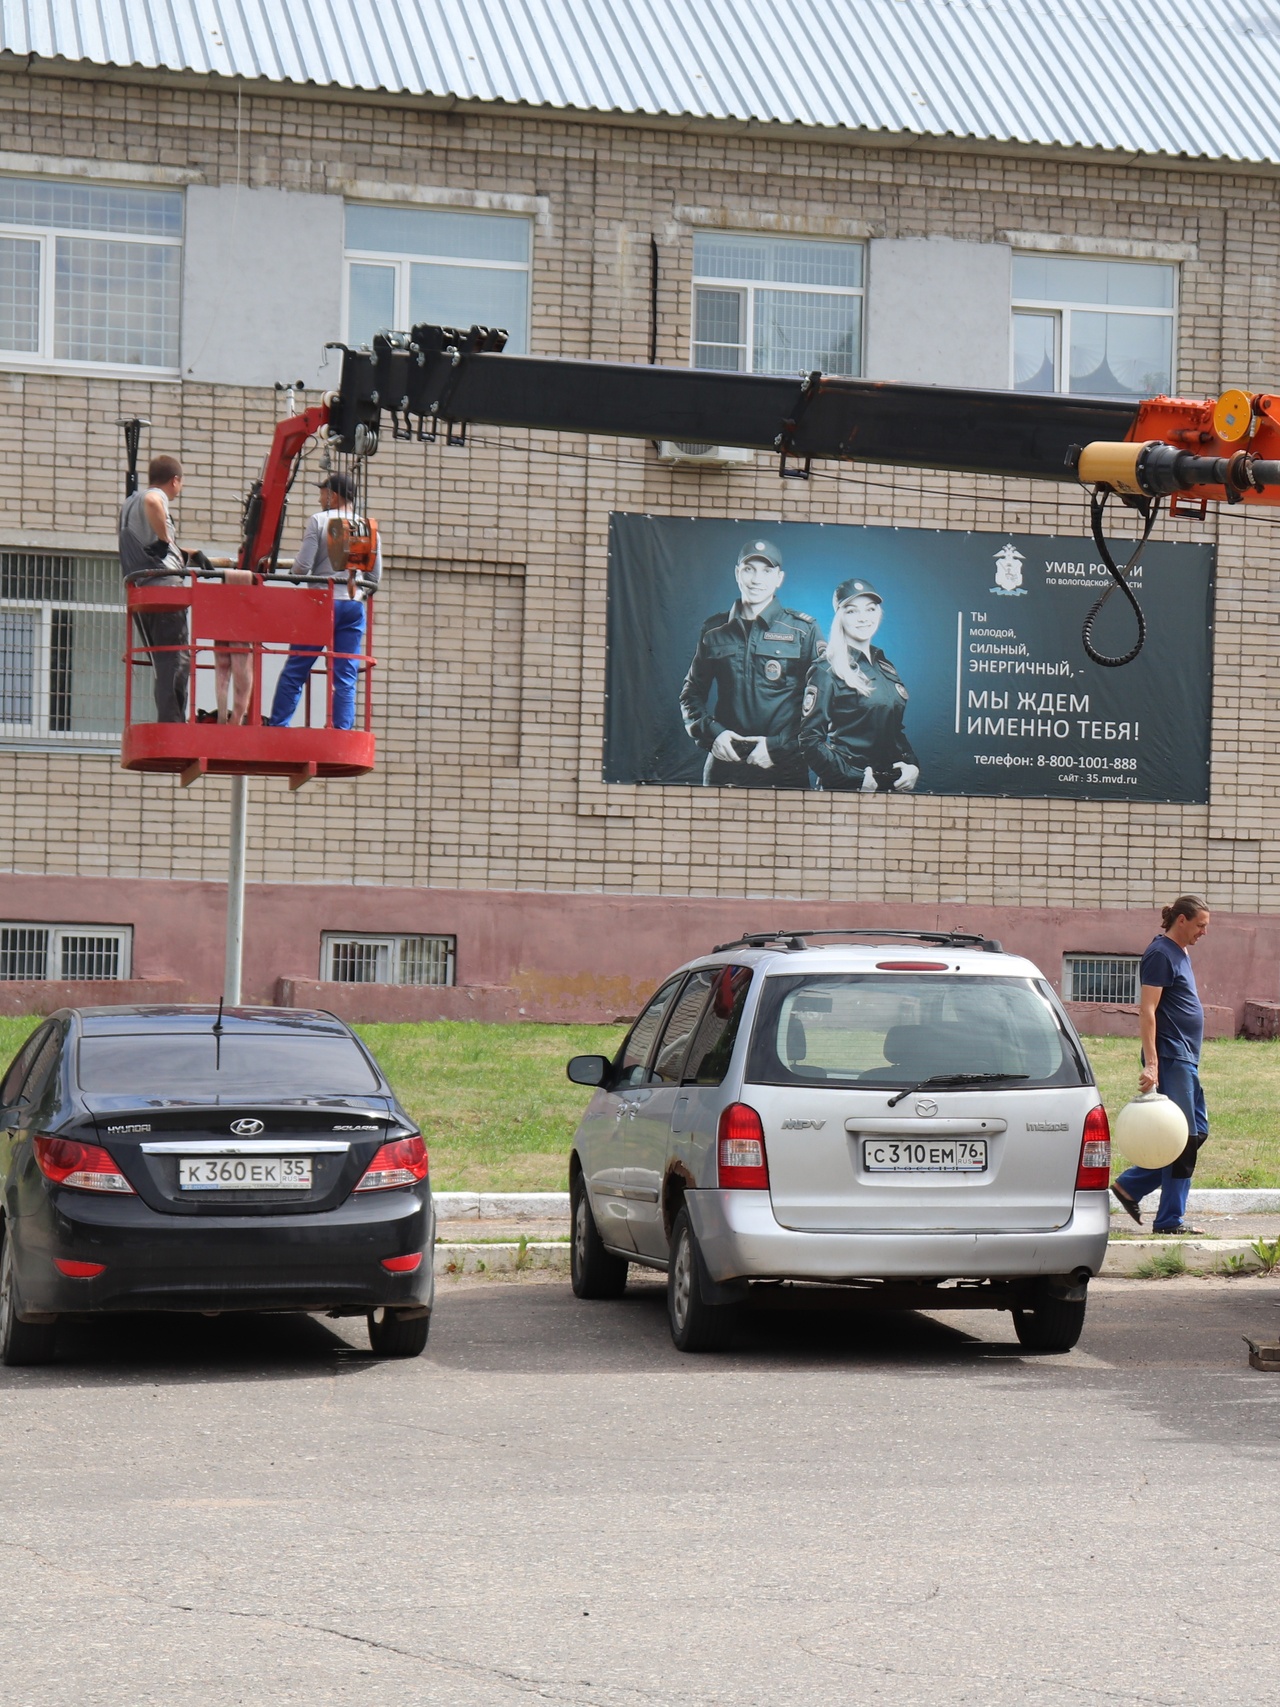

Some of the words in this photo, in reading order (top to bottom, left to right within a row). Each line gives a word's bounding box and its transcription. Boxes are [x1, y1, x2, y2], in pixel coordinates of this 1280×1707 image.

[1045, 561, 1085, 576] УМВД
[970, 611, 987, 622] ТЫ
[969, 643, 1030, 657] СИЛЬНЫЙ,
[969, 659, 1075, 678] ЭНЕРГИЧНЫЙ,
[968, 690, 1009, 710] МЫ
[1017, 691, 1090, 716] ЖДЕМ
[967, 716, 1070, 739] ИМЕННО
[1077, 720, 1140, 741] ТЕБЯ!
[974, 753, 1034, 768] телефон:
[1037, 754, 1138, 770] 8-800-1001-888
[1086, 773, 1138, 785] 35.mvd.ru
[107, 1124, 151, 1134] HYUNDAI
[781, 1118, 828, 1131] MPV
[1025, 1120, 1070, 1132] mazda
[958, 1143, 979, 1159] 76
[283, 1160, 305, 1176] 35
